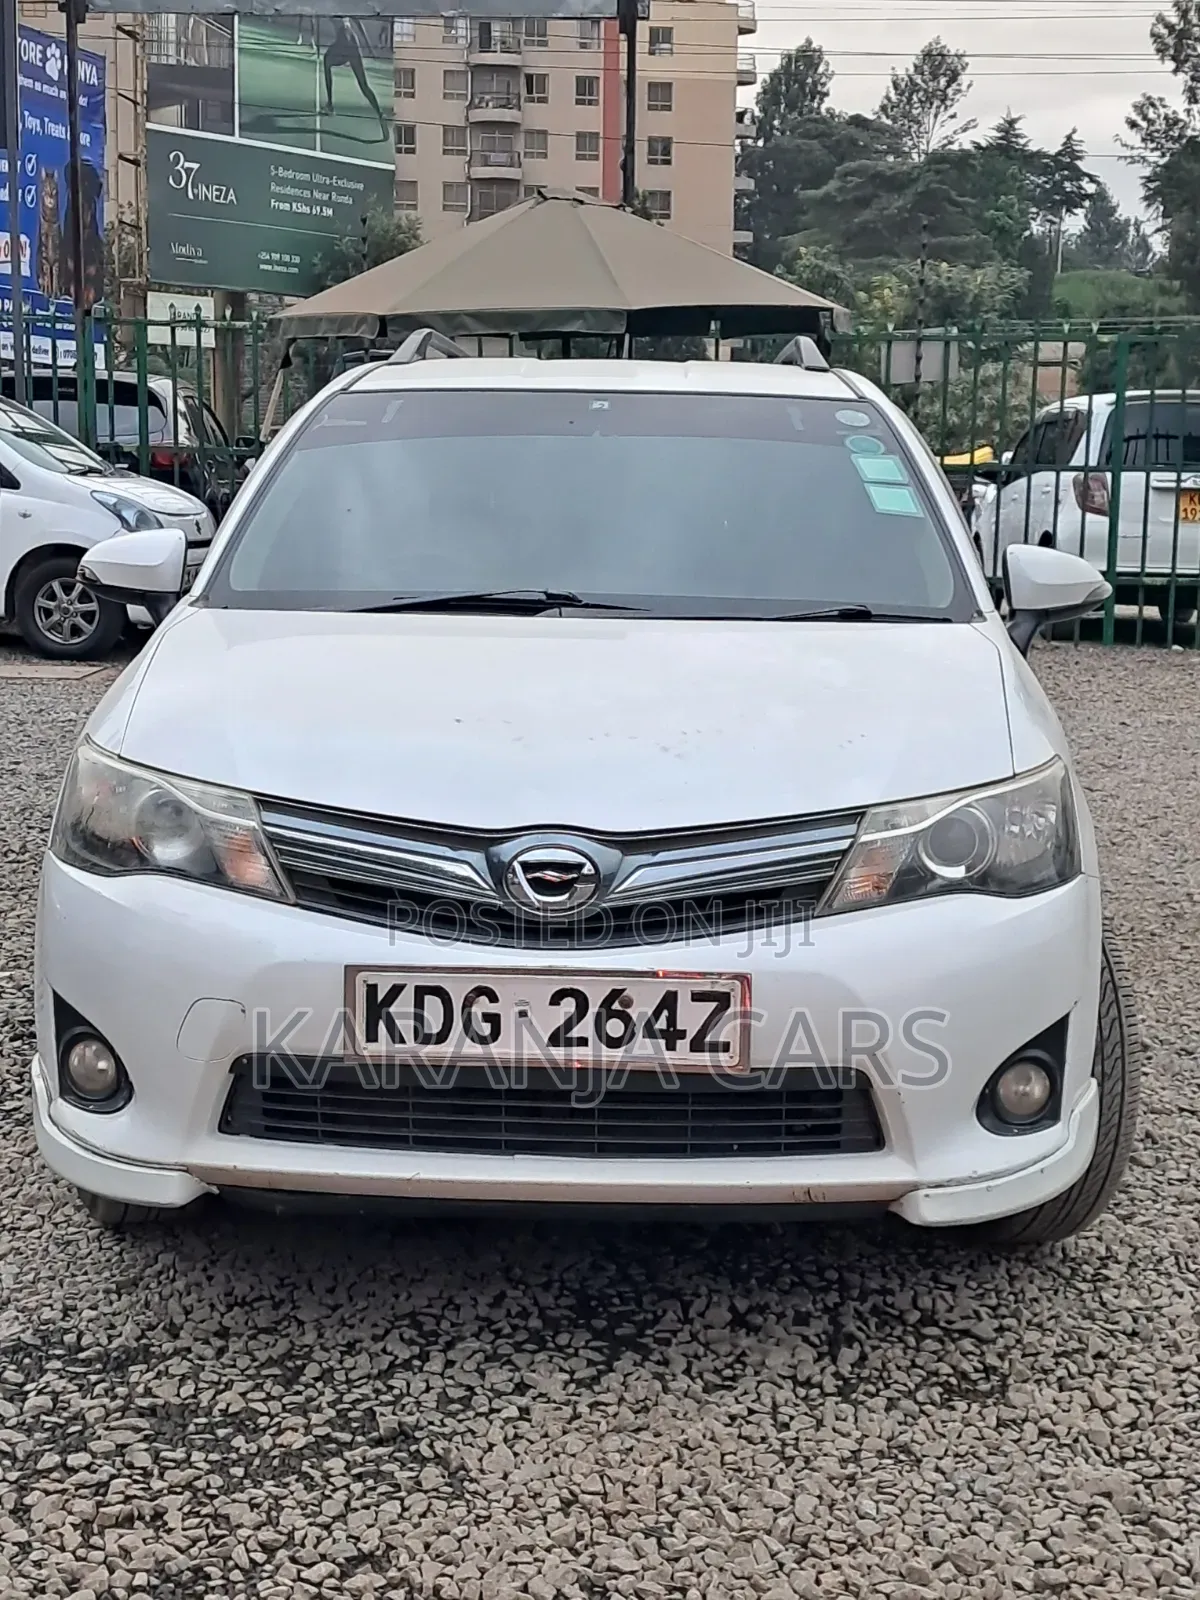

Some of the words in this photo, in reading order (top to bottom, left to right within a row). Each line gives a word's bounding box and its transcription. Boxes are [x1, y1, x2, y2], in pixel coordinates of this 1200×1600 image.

[23, 110, 42, 136] Toys,
[43, 116, 66, 140] Treats
[168, 150, 200, 200] 37
[198, 183, 237, 205] INEZA
[270, 182, 311, 199] Residences
[312, 189, 330, 201] Near
[270, 198, 291, 212] From
[1181, 507, 1200, 521] 19
[364, 982, 502, 1046] KDG
[547, 987, 732, 1054] 264Z
